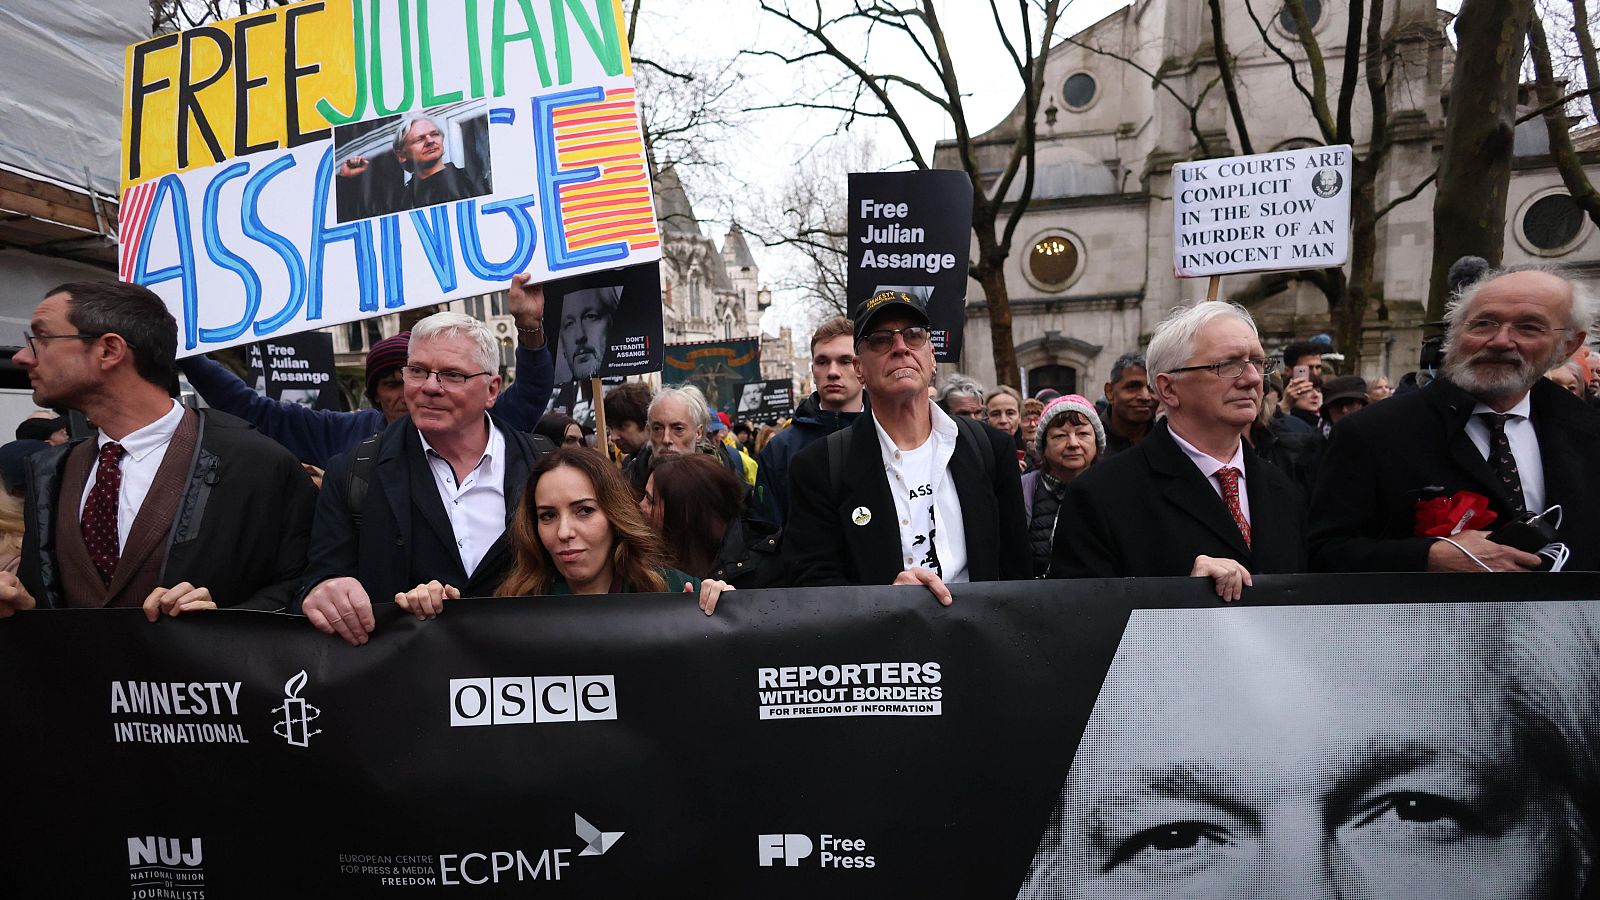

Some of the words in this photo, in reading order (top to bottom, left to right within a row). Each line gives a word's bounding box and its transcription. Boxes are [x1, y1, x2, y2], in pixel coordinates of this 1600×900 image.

[130, 2, 332, 180] FREE
[317, 0, 622, 123] JULIAN
[1181, 166, 1208, 183] UK
[1218, 157, 1296, 178] COURTS
[1305, 151, 1345, 168] ARE
[1180, 179, 1292, 204] COMPLICIT
[860, 199, 909, 219] Free
[1181, 210, 1200, 226] IN
[1211, 205, 1250, 222] THE
[1260, 199, 1316, 217] SLOW
[860, 223, 925, 244] Julian
[1181, 225, 1265, 247] MURDER
[1275, 222, 1301, 237] OF
[1309, 220, 1335, 235] AN
[860, 249, 956, 274] Assange
[1181, 246, 1282, 269] INNOCENT
[1291, 242, 1335, 259] MAN
[611, 343, 645, 351] EXTRADITE
[625, 335, 645, 343] DON'T
[267, 344, 296, 356] Free
[616, 350, 646, 358] ASSANGE
[270, 357, 309, 369] Julian
[271, 370, 330, 384] Assange
[758, 662, 942, 689] REPORTERS
[111, 681, 242, 716] AMNESTY
[759, 688, 849, 705] WITHOUT
[852, 686, 942, 701] BORDERS
[769, 708, 790, 716] FOR
[793, 706, 842, 715] FREEDOM
[844, 705, 858, 713] OF
[861, 704, 934, 713] INFORMATION
[113, 722, 250, 744] INTERNATIONAL
[127, 835, 203, 867] NUJ
[758, 833, 813, 867] FP
[820, 834, 866, 851] Free
[339, 853, 392, 863] EUROPEAN
[395, 855, 434, 864] CENTRE
[439, 848, 572, 886] ECPMF
[820, 851, 876, 868] Press
[130, 871, 173, 880] NATIONAL
[176, 873, 204, 881] UNION
[340, 865, 360, 874] FOR
[362, 866, 391, 875] PRESS
[393, 866, 400, 875] &
[402, 866, 435, 875] MEDIA
[381, 877, 436, 886] FREEDOM
[132, 888, 205, 900] JOURNALISTS
